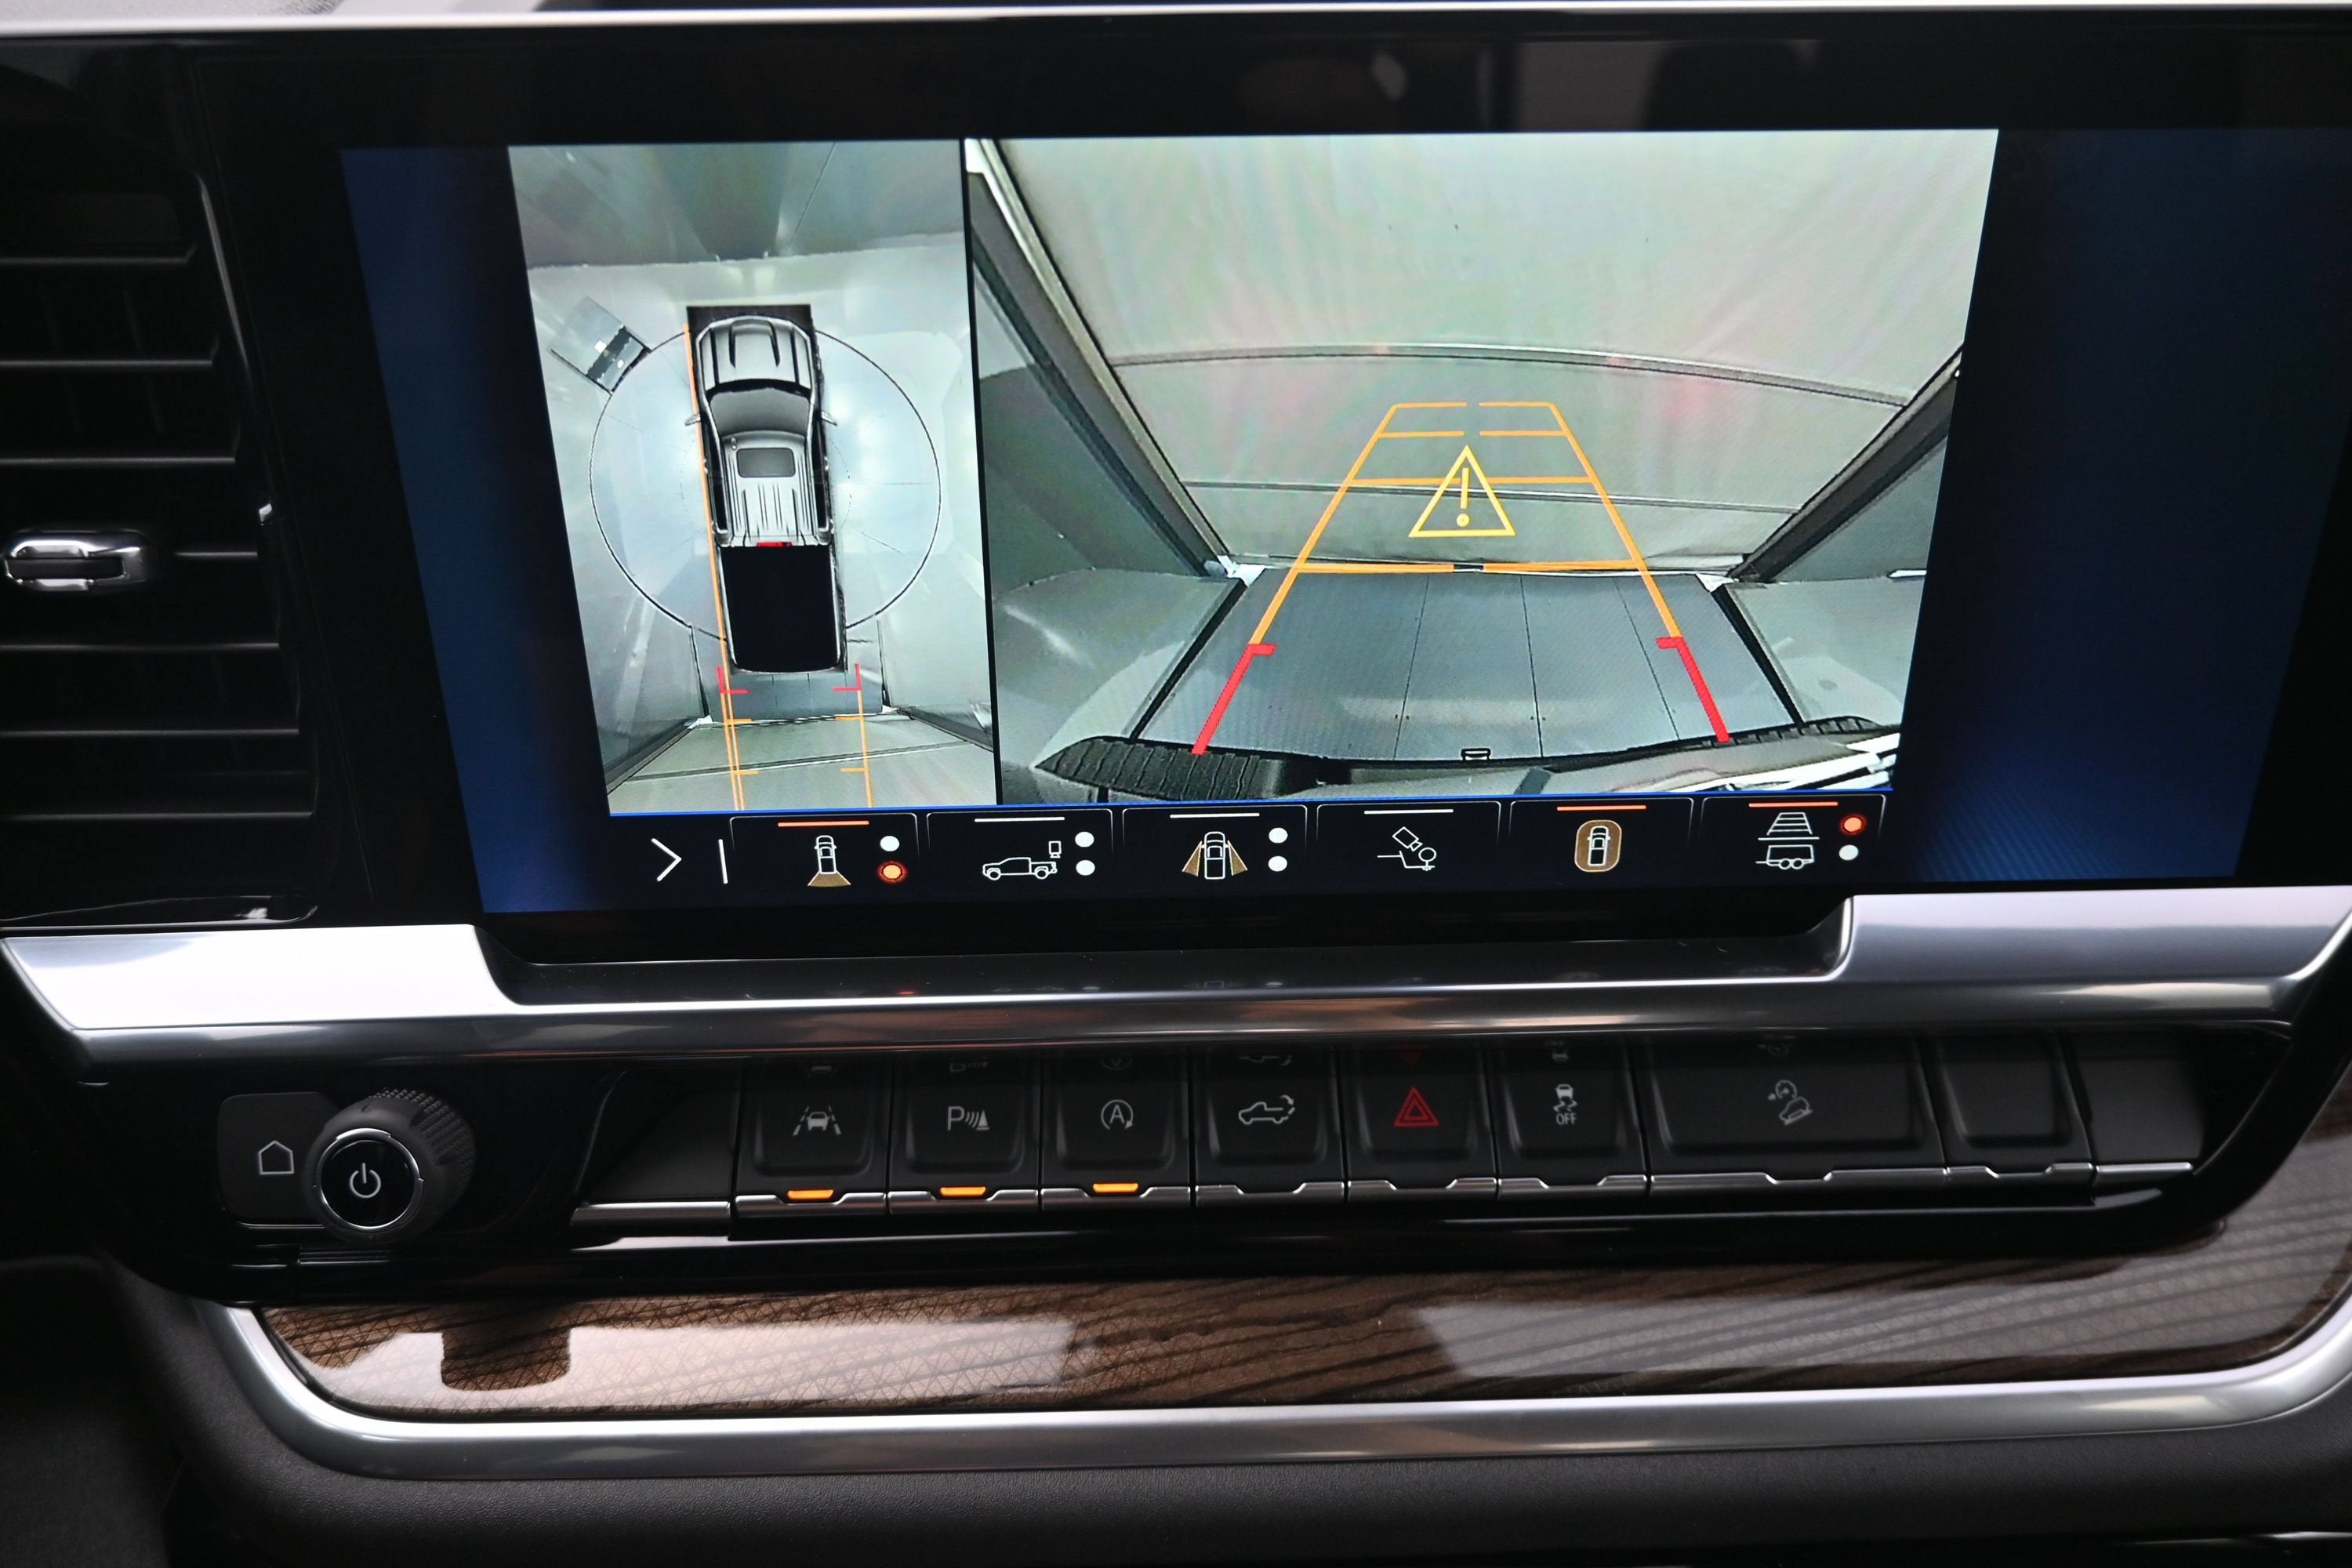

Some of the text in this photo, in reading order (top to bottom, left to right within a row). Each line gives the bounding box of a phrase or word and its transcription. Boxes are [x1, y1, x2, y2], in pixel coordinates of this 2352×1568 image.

[947, 1105, 965, 1131] P
[1109, 1104, 1126, 1123] A
[1555, 1112, 1577, 1126] OFF
